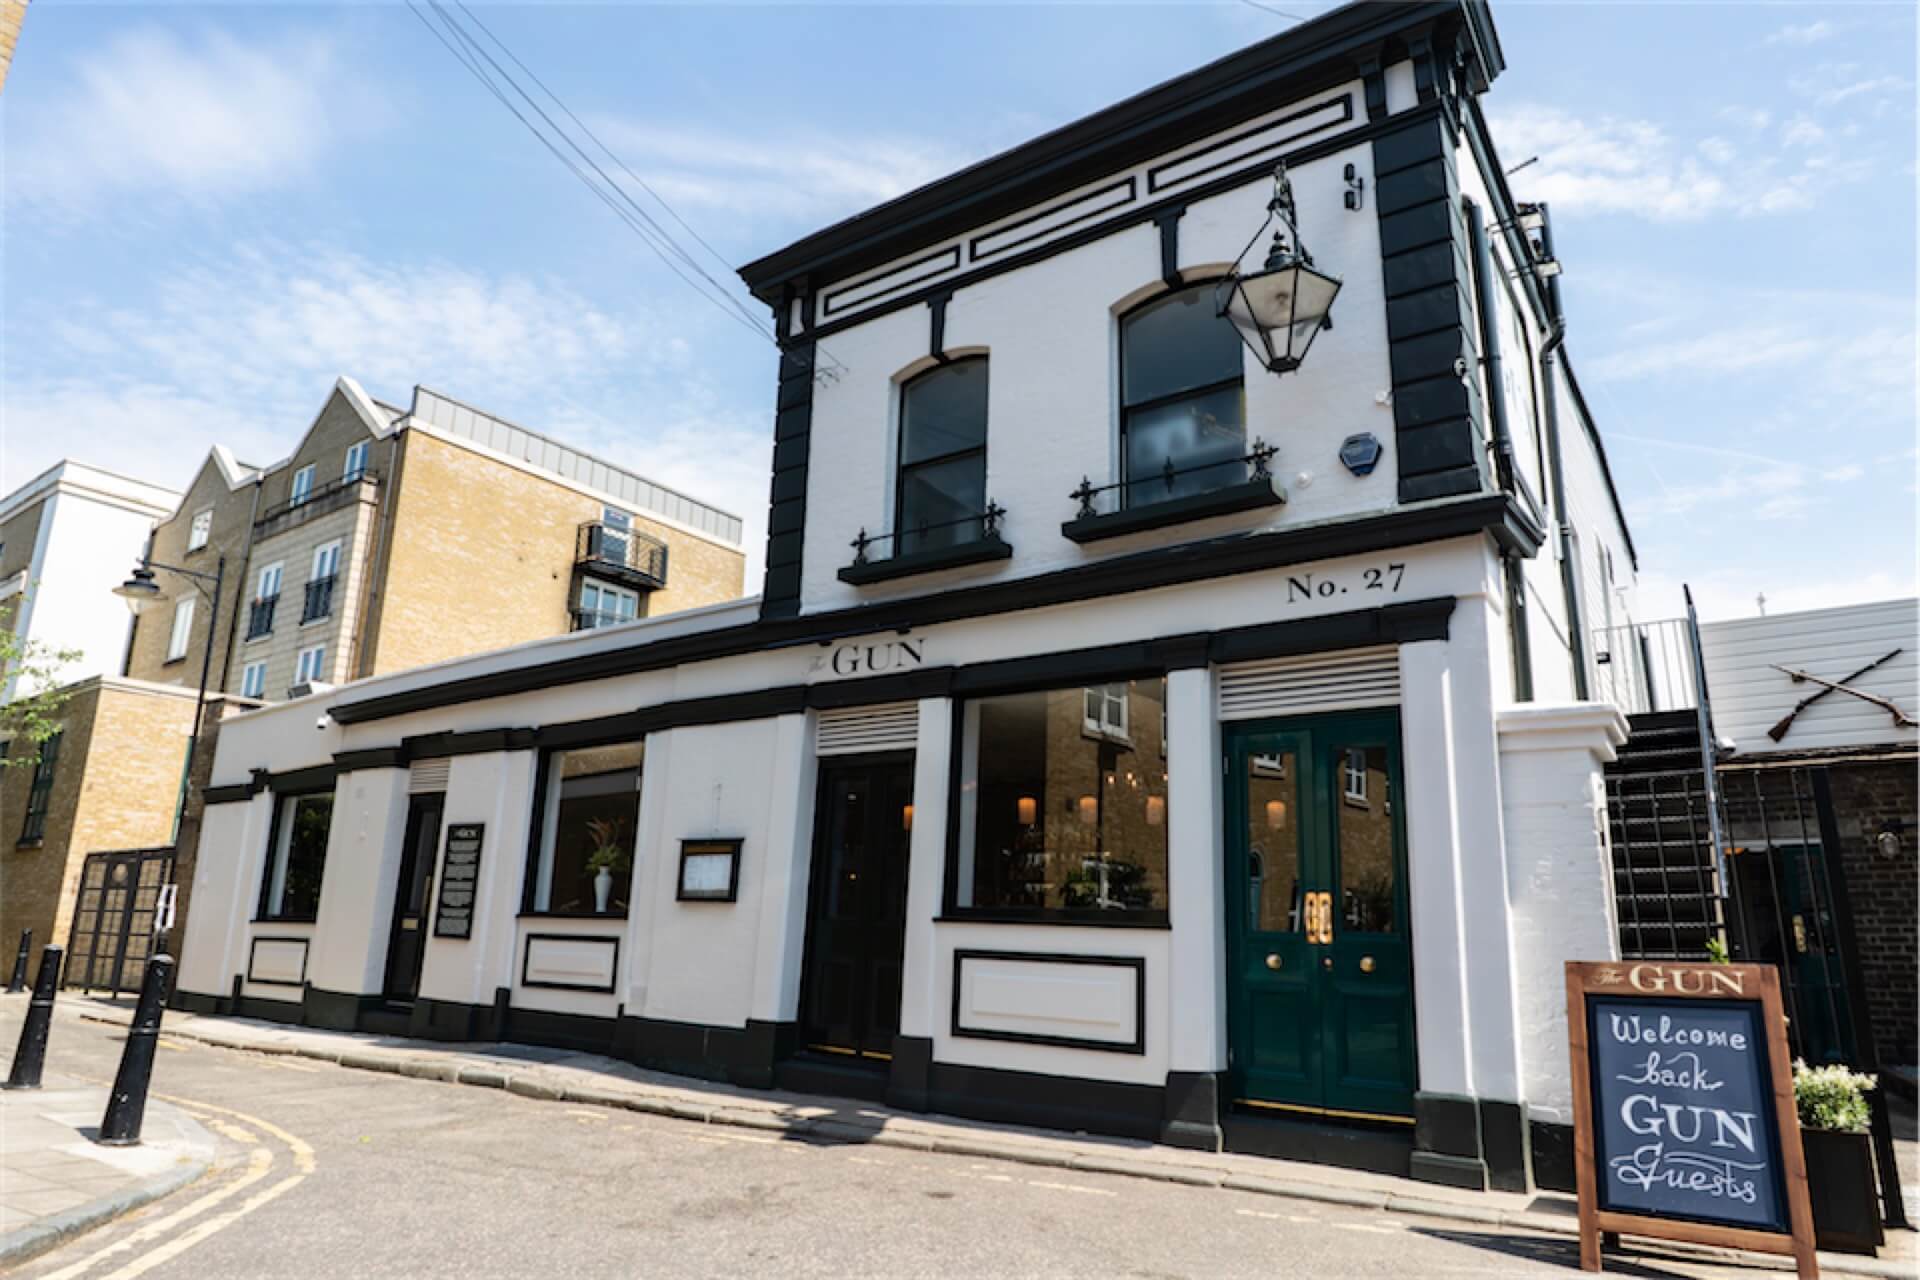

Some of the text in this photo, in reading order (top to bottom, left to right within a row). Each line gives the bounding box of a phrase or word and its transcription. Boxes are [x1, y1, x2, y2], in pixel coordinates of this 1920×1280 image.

[1285, 563, 1406, 603] No. 27
[832, 638, 926, 676] GUN
[1629, 963, 1746, 995] GUN
[1609, 1013, 1747, 1051] Welcome
[1616, 1051, 1725, 1091] back
[1620, 1094, 1760, 1153] GUN
[1609, 1142, 1766, 1203] Guests
